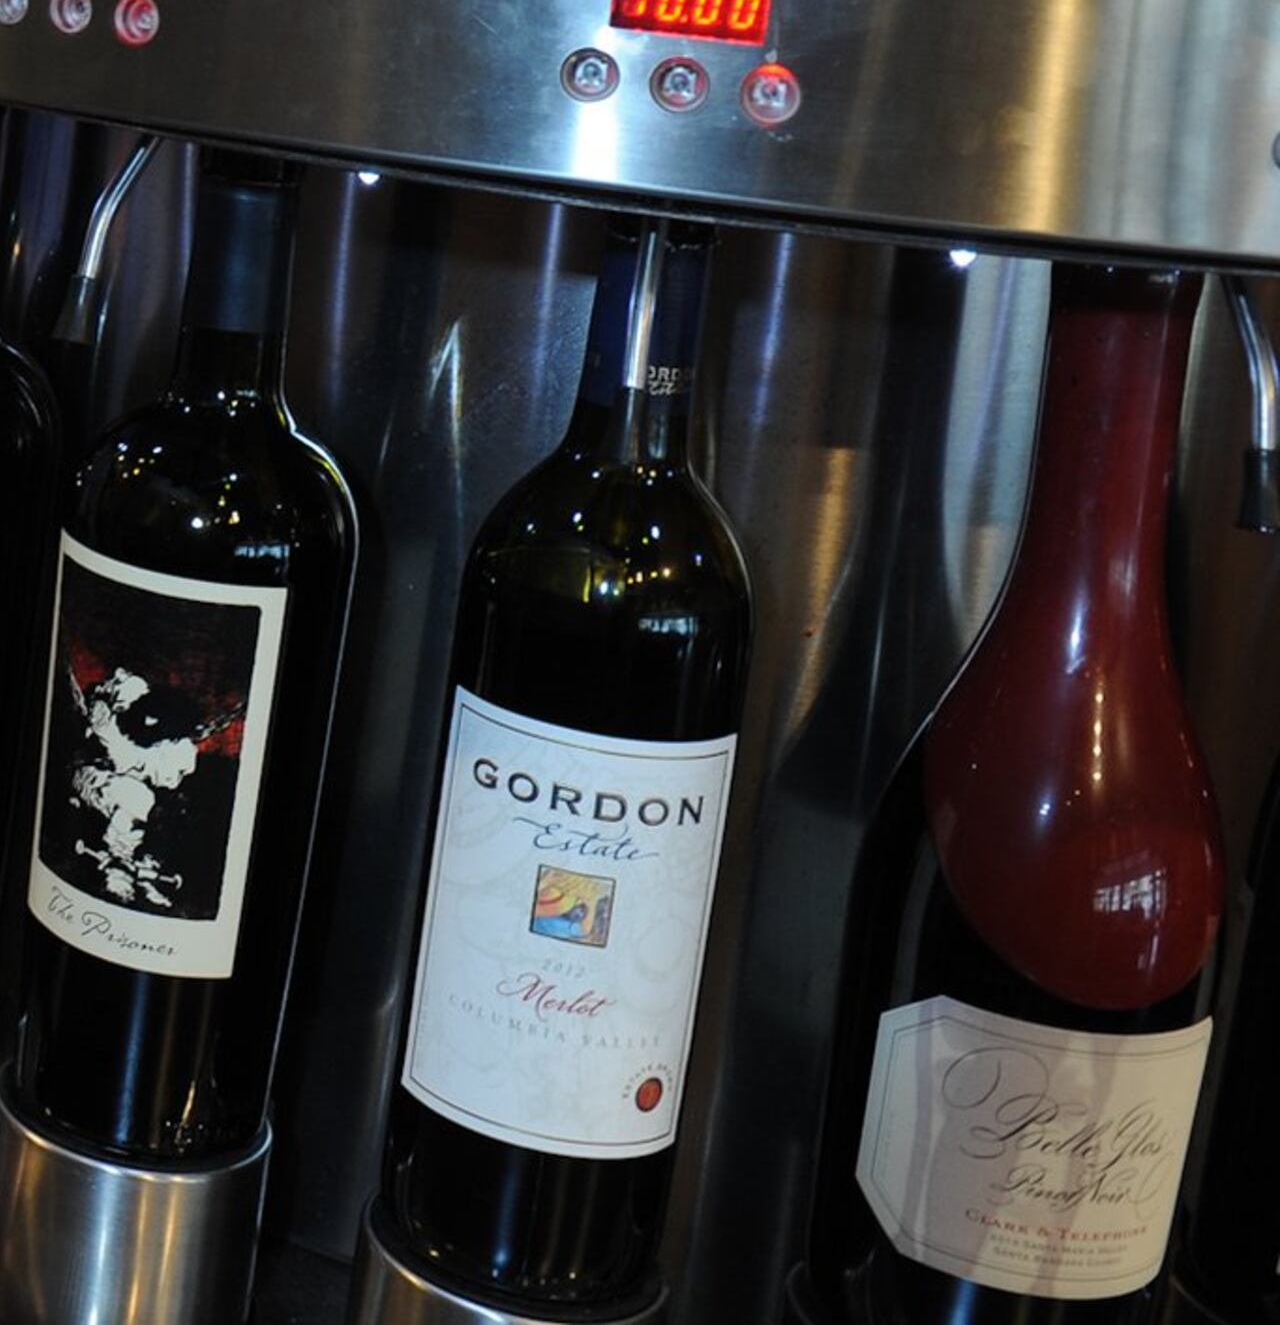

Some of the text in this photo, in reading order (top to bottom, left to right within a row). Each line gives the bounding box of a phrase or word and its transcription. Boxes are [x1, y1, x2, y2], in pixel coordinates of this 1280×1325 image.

[471, 757, 706, 828] GORDON
[512, 815, 661, 863] Estate
[46, 885, 178, 957] The Prisoner
[448, 993, 567, 1044] COLUMBIA
[495, 972, 619, 1024] Merlot
[988, 1163, 1086, 1213] Pinot
